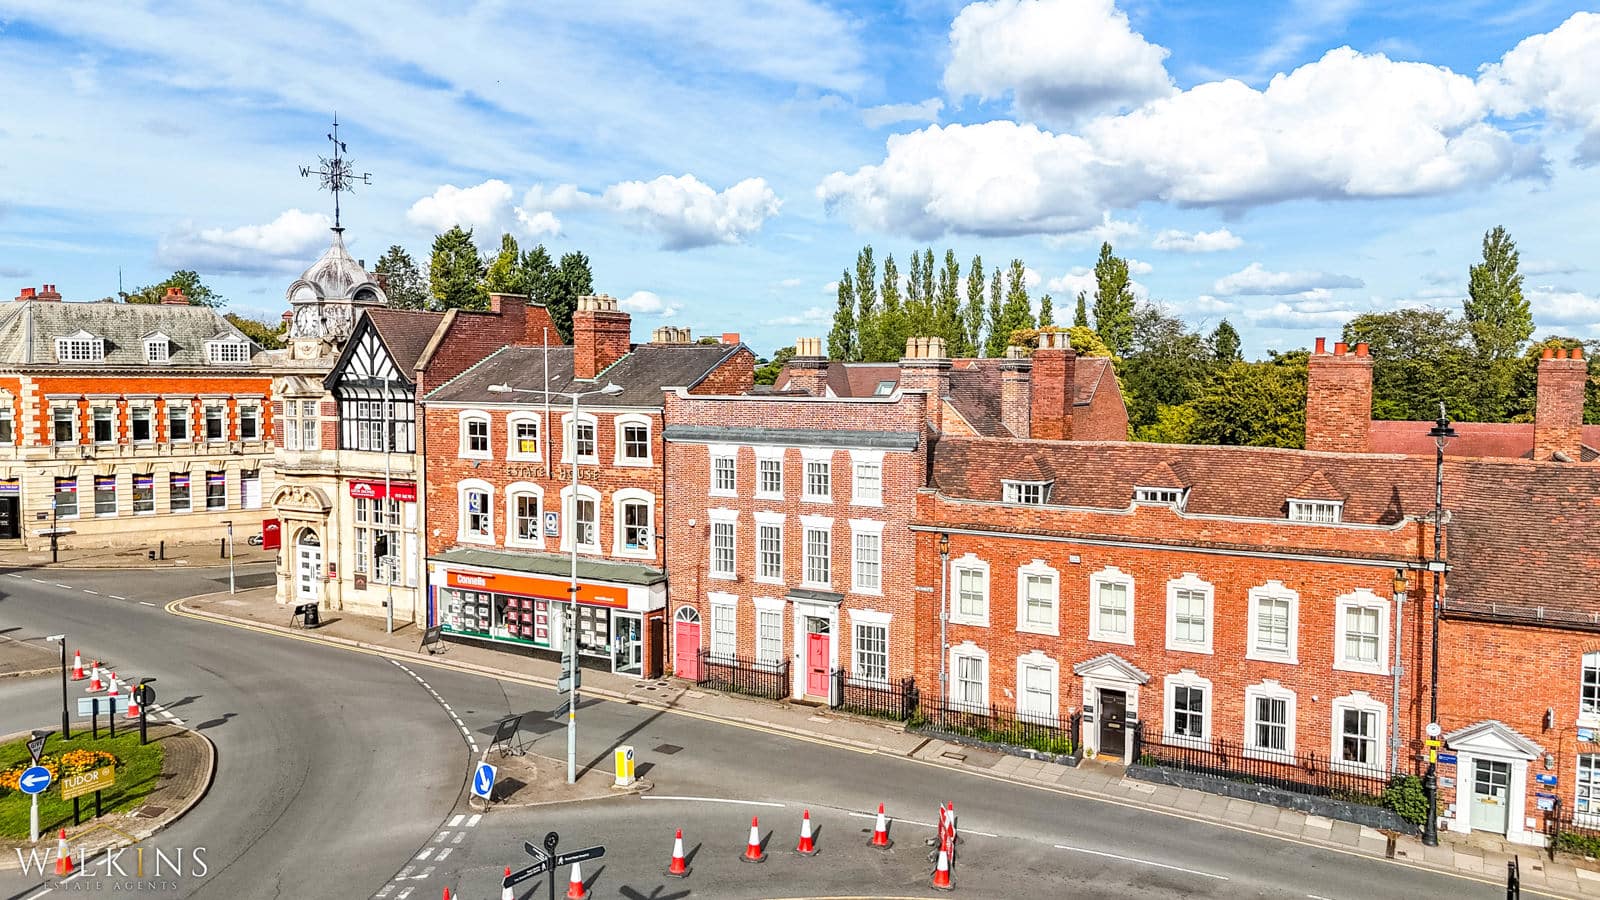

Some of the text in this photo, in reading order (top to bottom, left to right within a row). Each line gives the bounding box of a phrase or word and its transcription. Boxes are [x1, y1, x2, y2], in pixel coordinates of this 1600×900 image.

[298, 165, 310, 177] W
[364, 172, 372, 185] E
[507, 466, 546, 478] ESTATE
[457, 574, 486, 587] Connells
[64, 770, 99, 789] TUDOR
